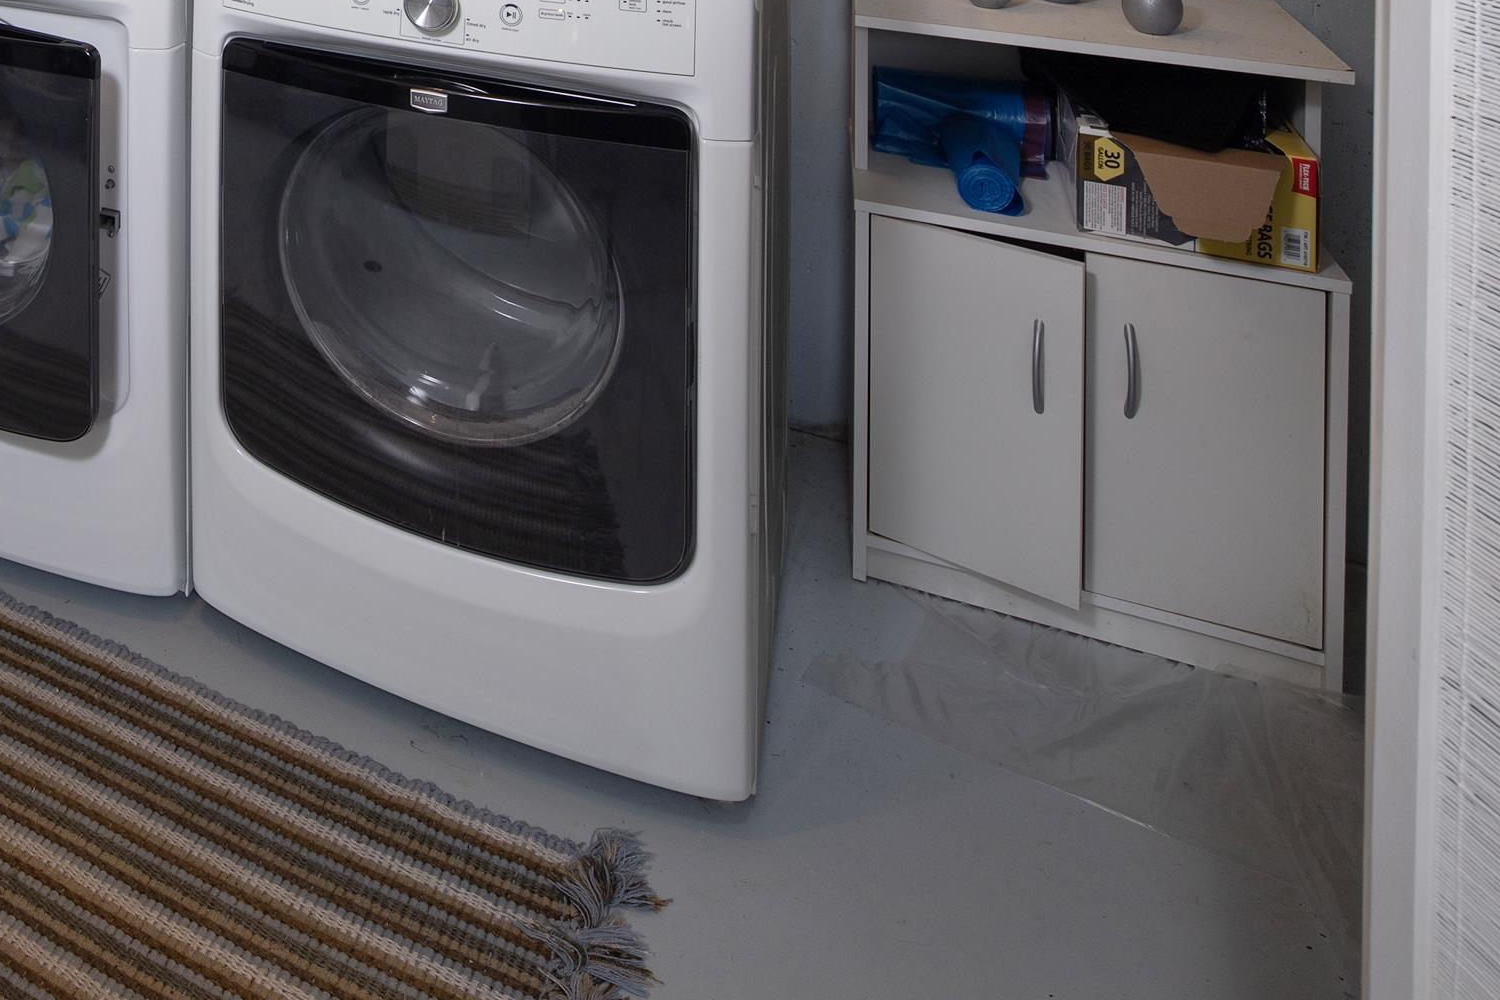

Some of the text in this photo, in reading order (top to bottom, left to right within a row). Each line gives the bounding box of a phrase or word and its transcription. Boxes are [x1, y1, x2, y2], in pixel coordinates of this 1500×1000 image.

[413, 95, 443, 106] MAYTAG
[1104, 149, 1120, 169] 30
[1257, 225, 1273, 259] BAGS
